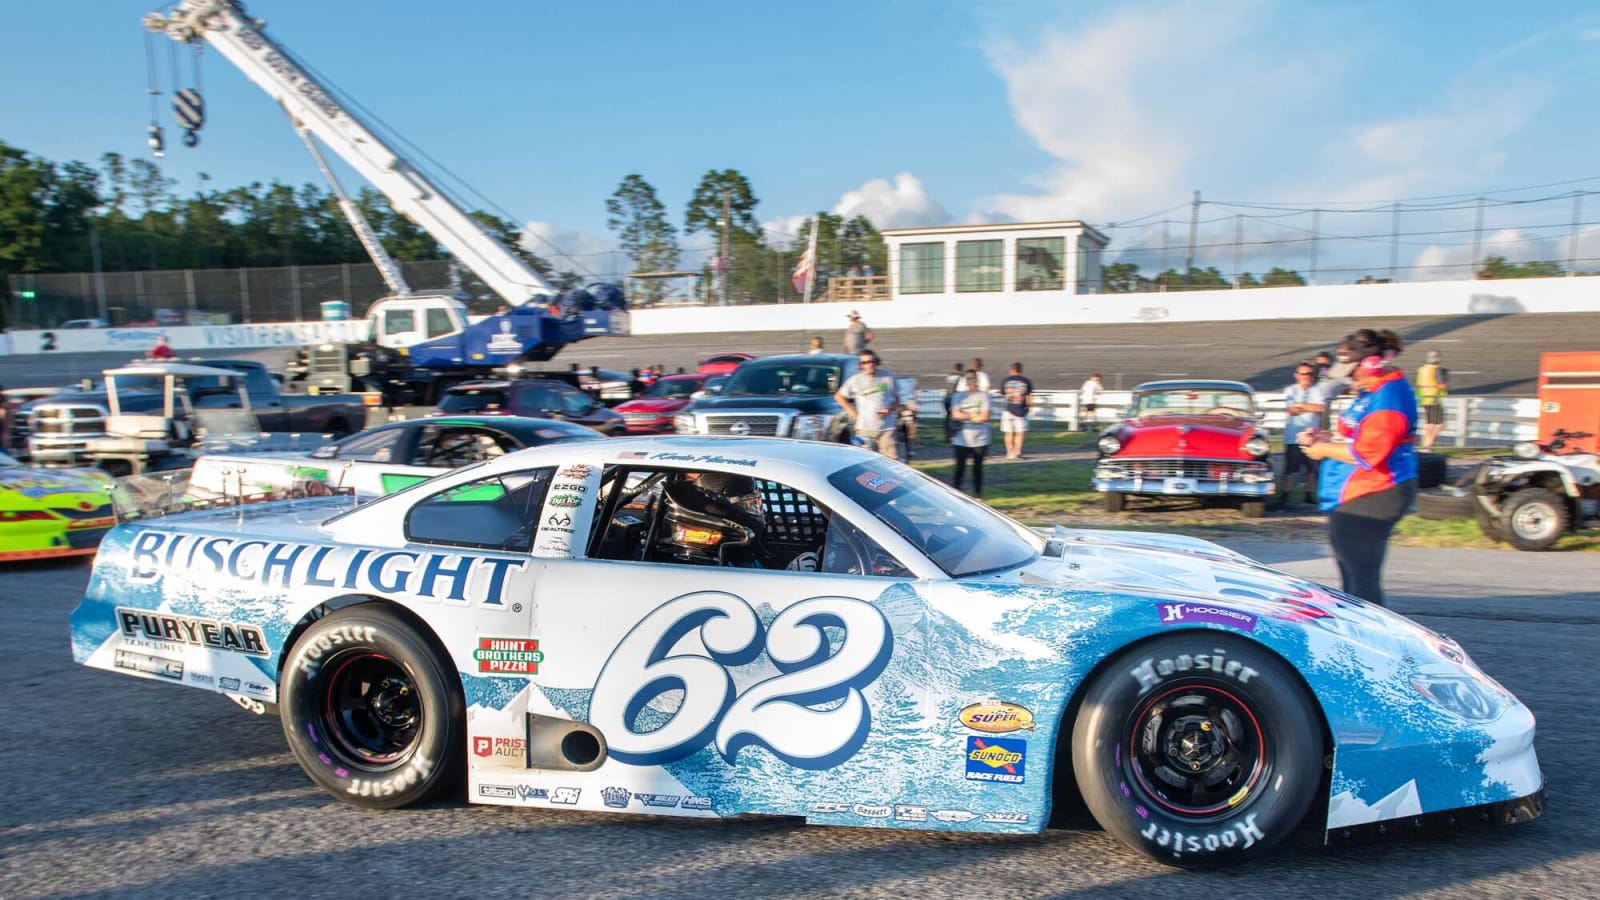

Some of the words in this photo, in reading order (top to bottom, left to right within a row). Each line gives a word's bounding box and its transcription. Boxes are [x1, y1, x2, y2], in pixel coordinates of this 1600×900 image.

[40, 331, 56, 350] 2
[1185, 606, 1253, 624] HOOSIER
[119, 610, 269, 656] PURYEAR
[124, 638, 150, 649] TANK
[154, 643, 183, 653] LINES
[491, 640, 527, 651] HUNT
[476, 649, 541, 662] BROTHERS
[490, 661, 528, 672] PIZZA
[1130, 648, 1260, 696] Hoosier
[588, 590, 894, 770] 62
[969, 712, 1017, 723] SUPER
[972, 751, 1020, 763] SUNOCO
[966, 771, 993, 780] RACE
[993, 774, 1024, 783] FUELS
[857, 805, 888, 816] Bassett
[1141, 812, 1264, 858] Hoosier
